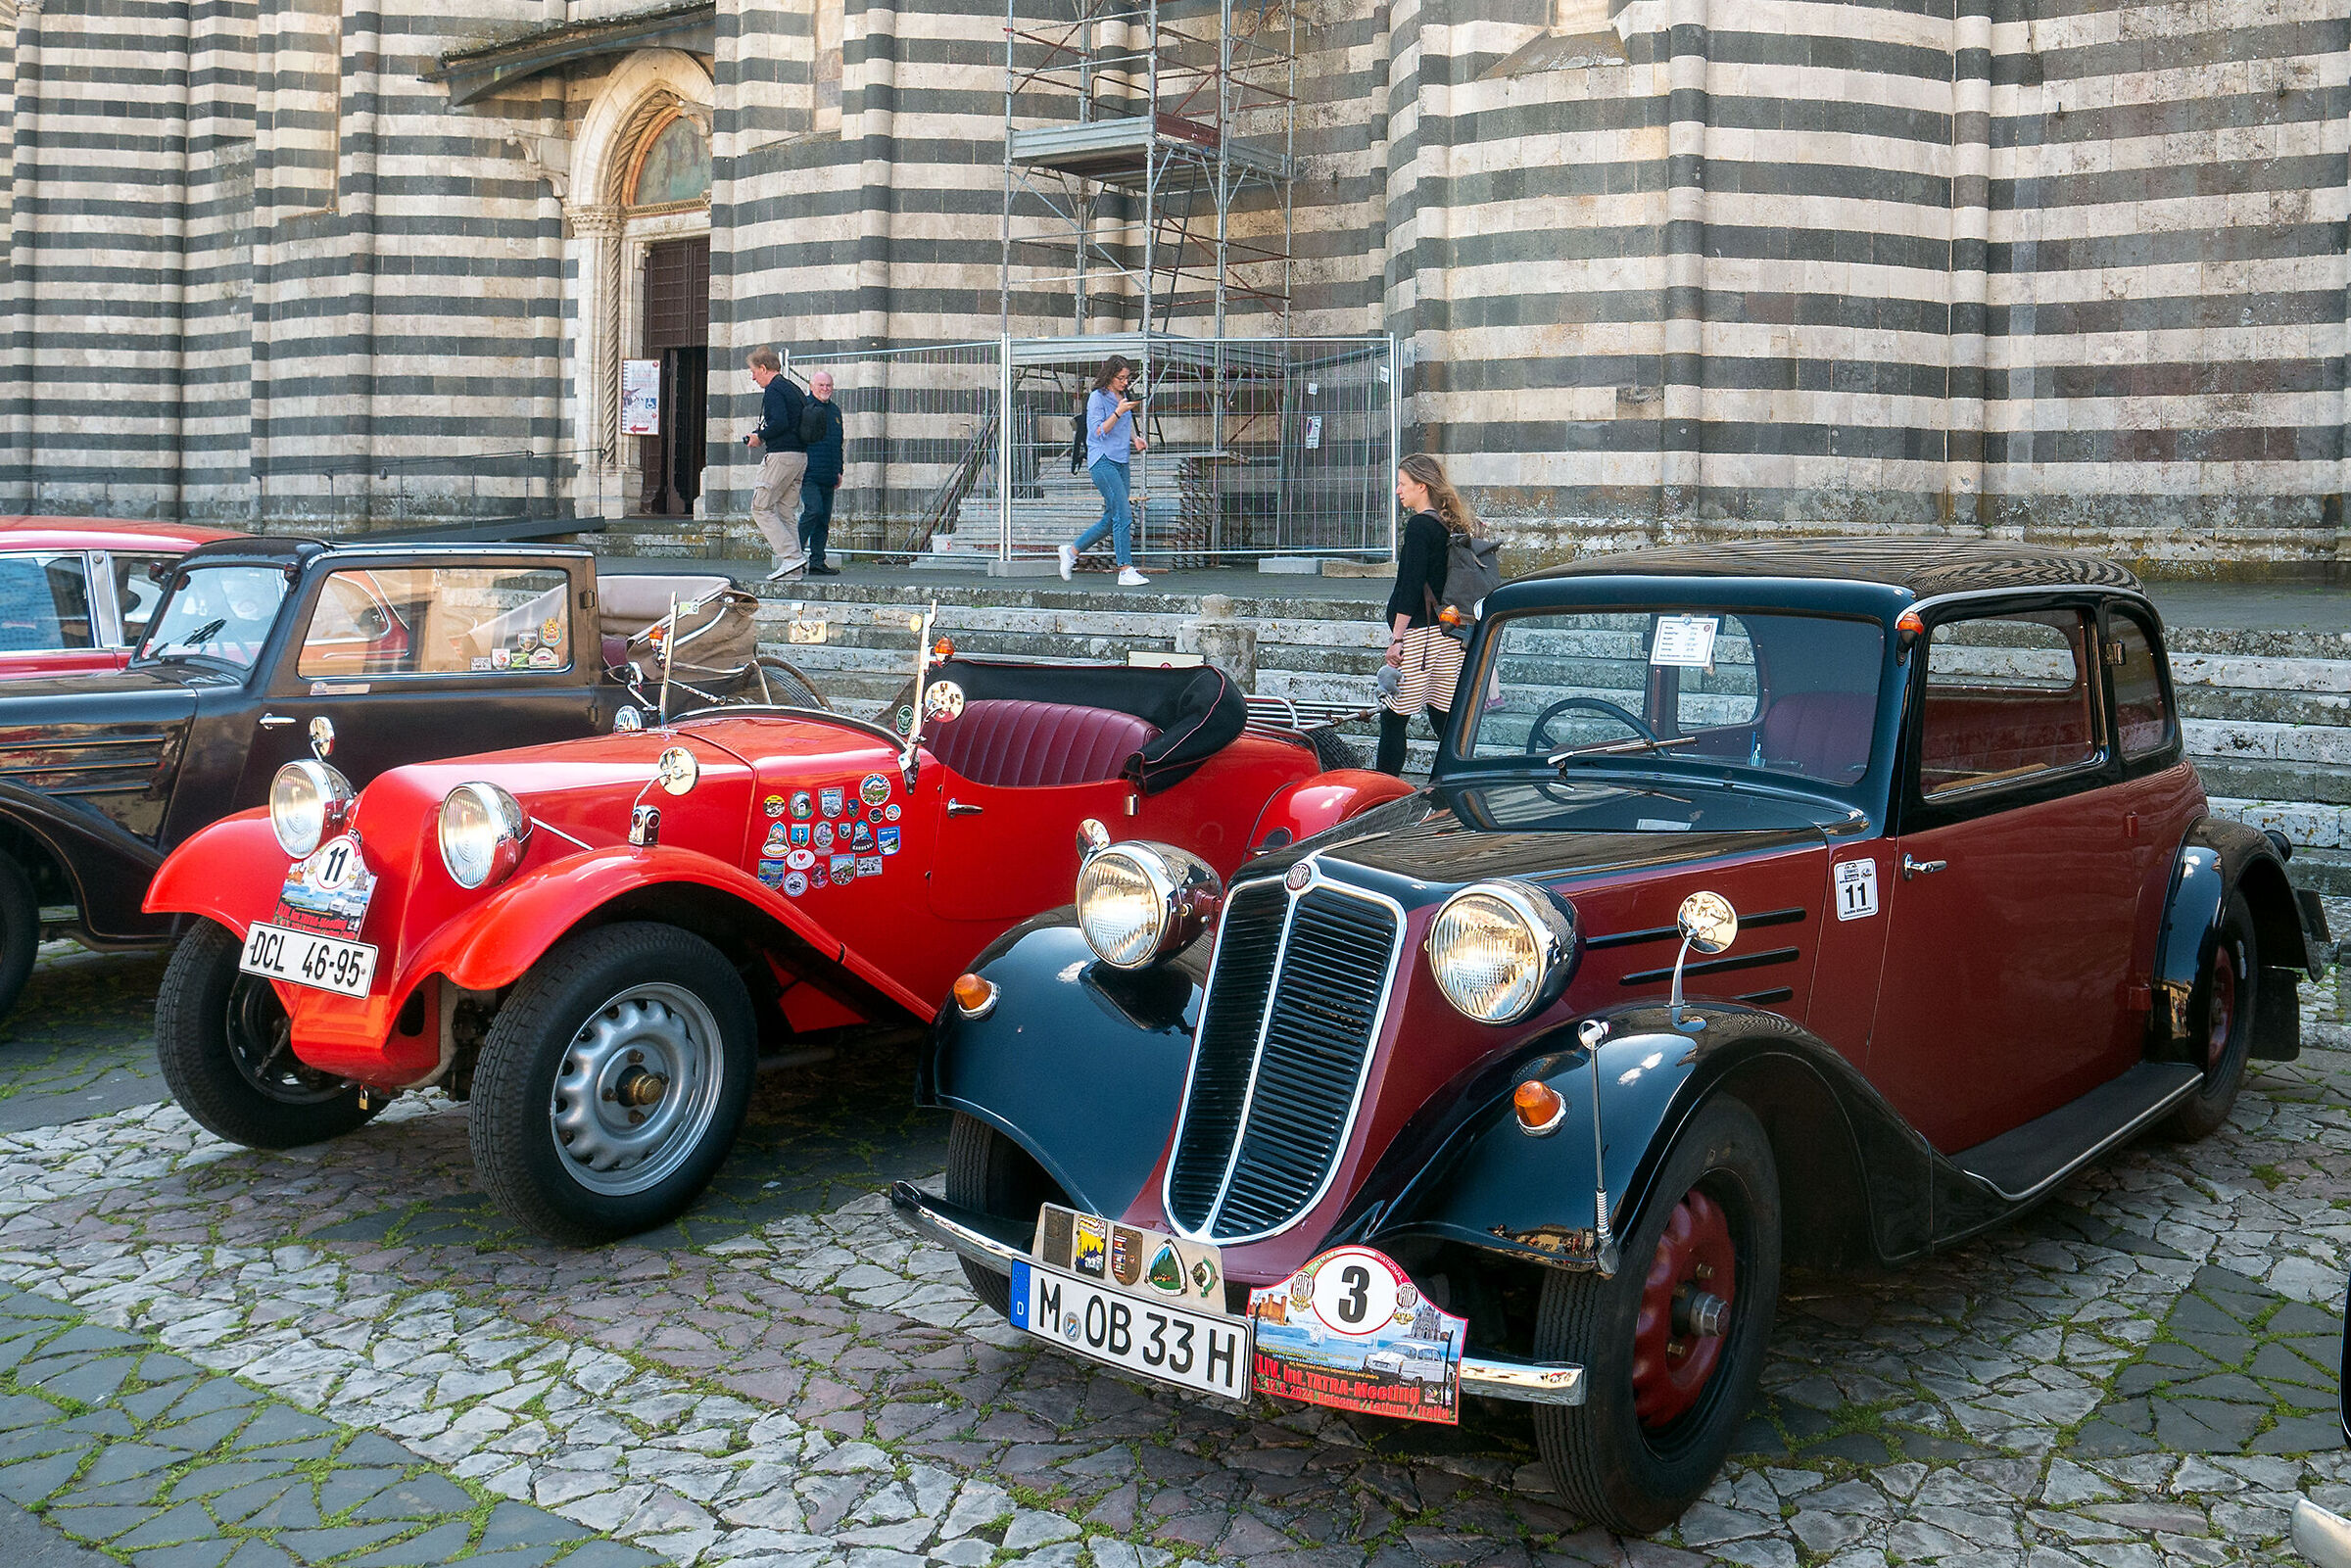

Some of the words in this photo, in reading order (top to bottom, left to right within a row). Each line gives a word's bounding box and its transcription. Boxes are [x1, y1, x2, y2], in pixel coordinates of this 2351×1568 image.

[324, 847, 349, 881] 11
[1846, 882, 1866, 908] 11
[250, 931, 285, 973] DCL
[302, 942, 364, 987] 46-95
[1017, 1301, 1024, 1315] D
[1338, 1265, 1369, 1323] 3
[1039, 1278, 1061, 1333] M
[1085, 1295, 1131, 1355] OB
[1142, 1311, 1194, 1373] 33
[1307, 1371, 1420, 1404] TATRA-Meeting
